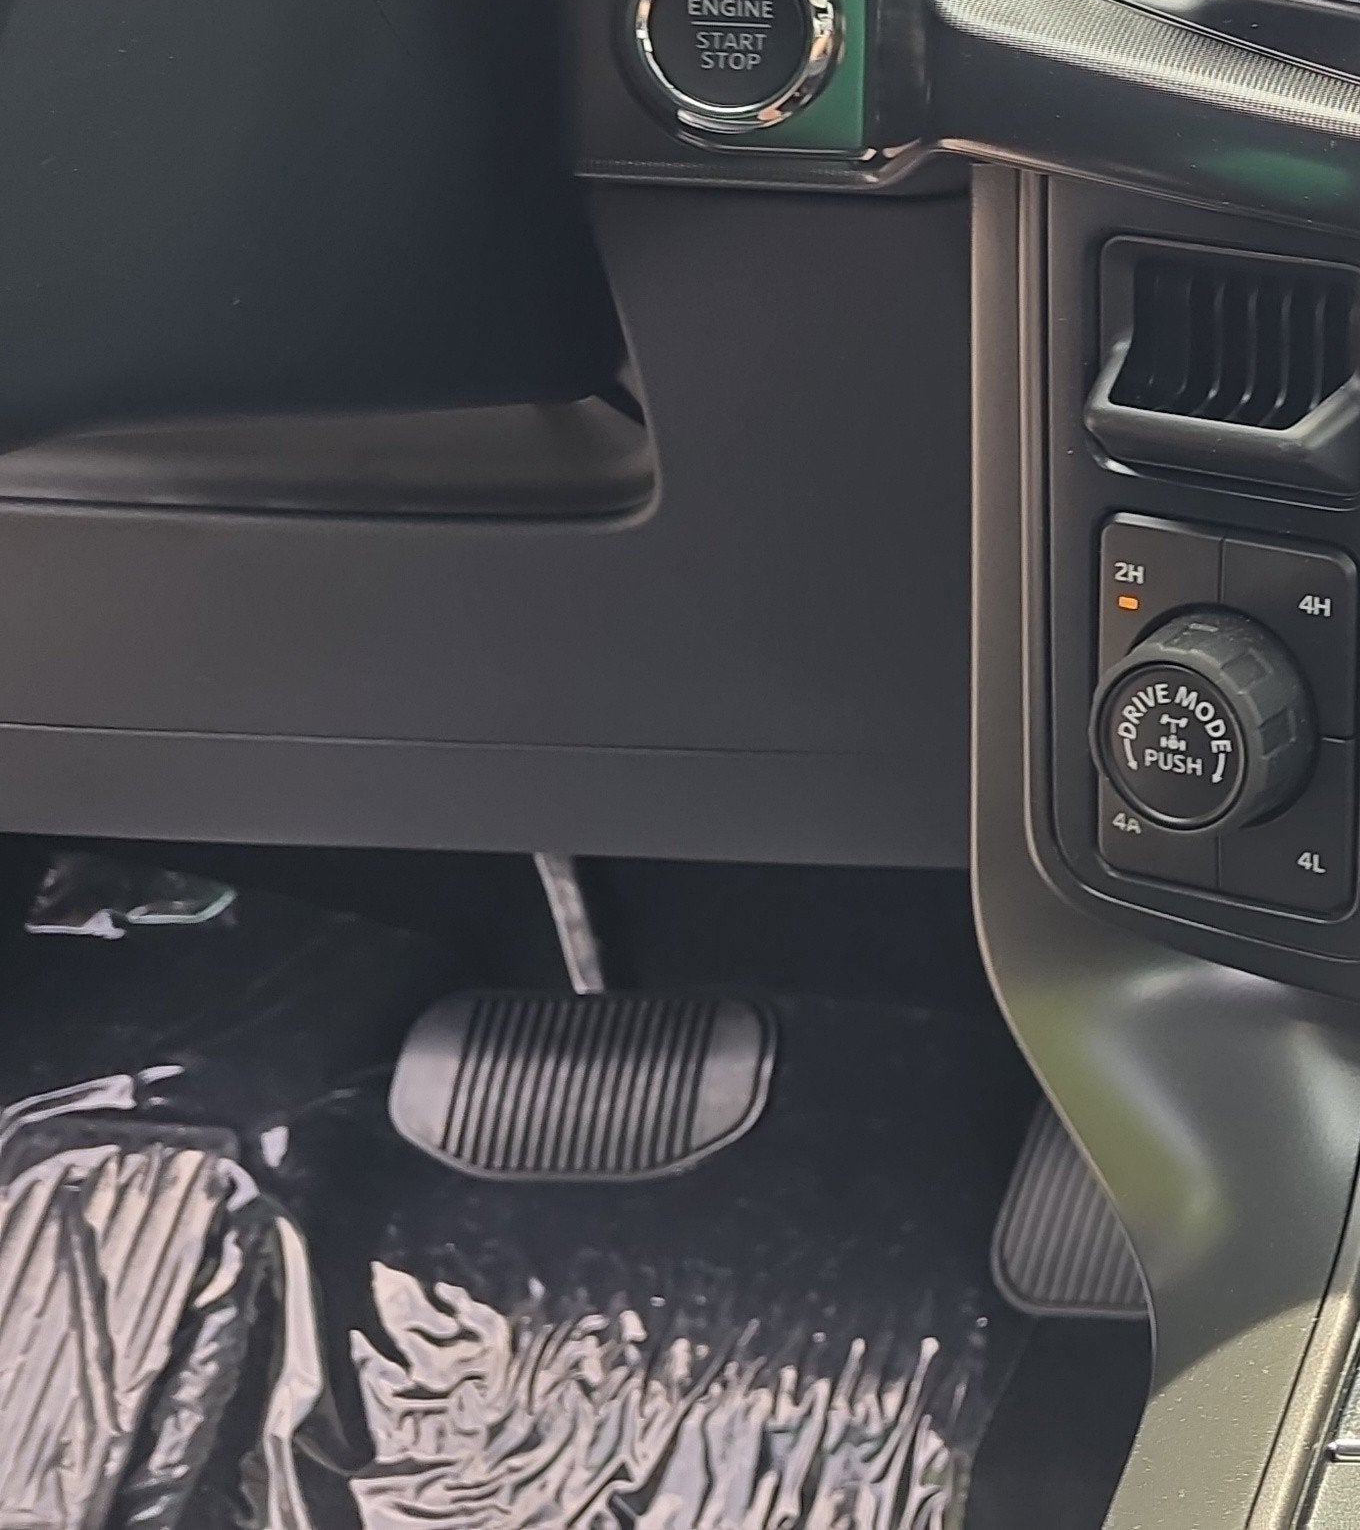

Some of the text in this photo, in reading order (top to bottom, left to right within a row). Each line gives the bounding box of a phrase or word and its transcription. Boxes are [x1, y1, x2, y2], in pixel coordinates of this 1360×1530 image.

[695, 31, 767, 51] START
[700, 51, 762, 71] STOP
[1113, 562, 1145, 585] 2H
[1298, 594, 1332, 618] 4H
[1118, 682, 1233, 754] DRIVE MODE
[1144, 748, 1203, 777] PUSH
[1112, 812, 1141, 834] 4A
[1297, 851, 1327, 874] 4L
